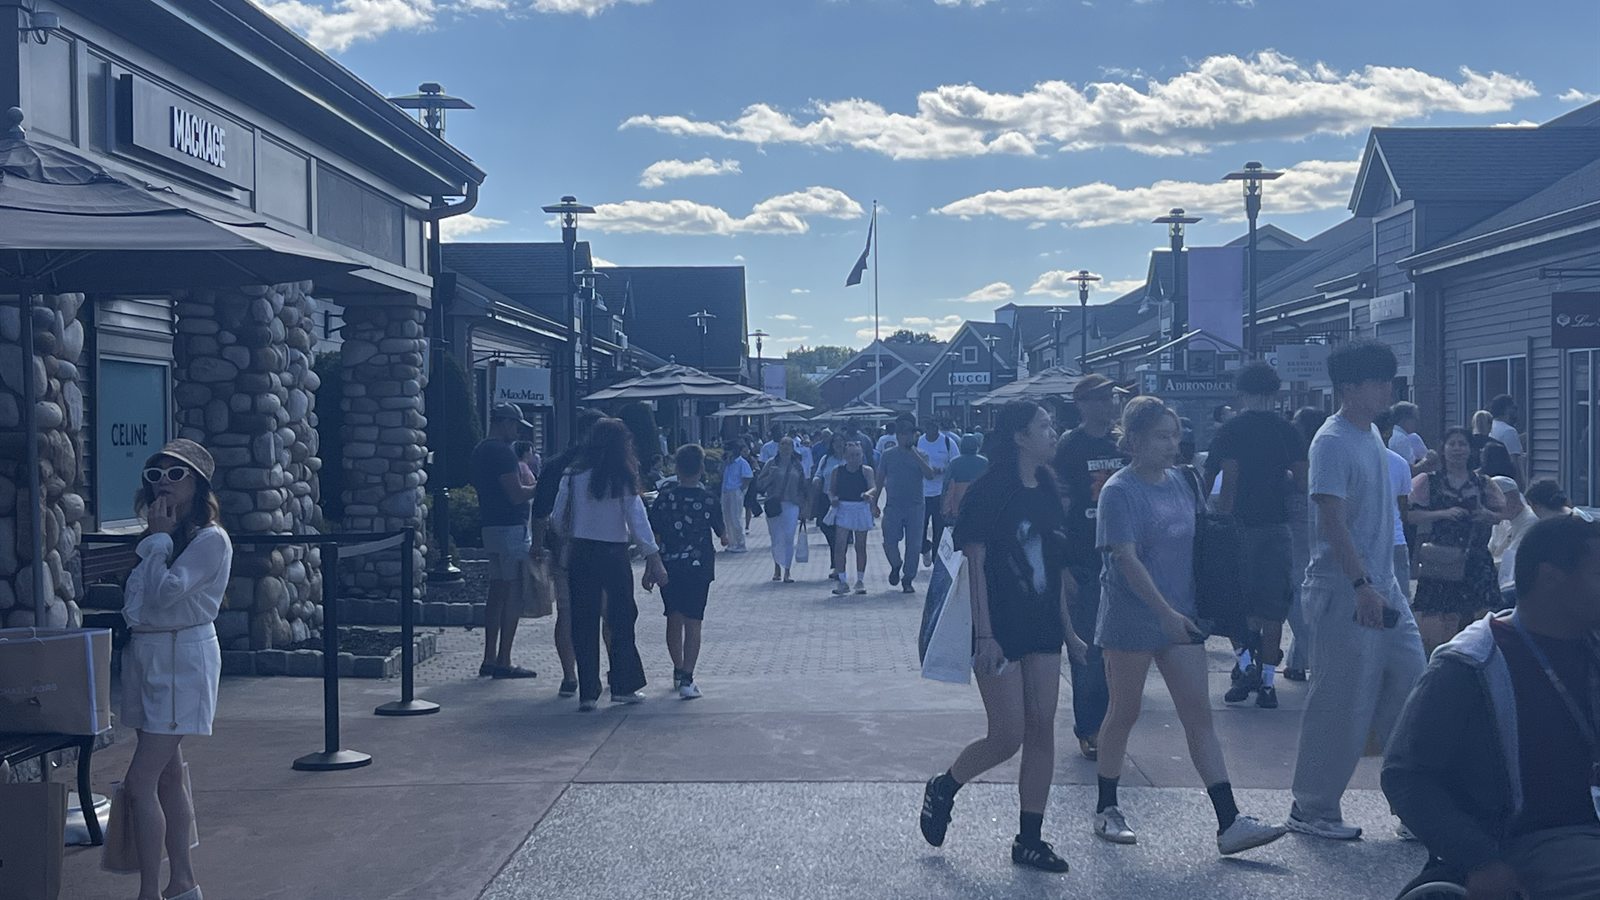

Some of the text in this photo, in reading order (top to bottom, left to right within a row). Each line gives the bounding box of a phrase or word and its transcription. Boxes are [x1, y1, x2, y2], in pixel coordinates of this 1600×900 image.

[172, 106, 226, 168] MACKAGE
[950, 374, 987, 383] GUCCI
[500, 388, 545, 401] MaxMara
[111, 423, 148, 446] CELINE
